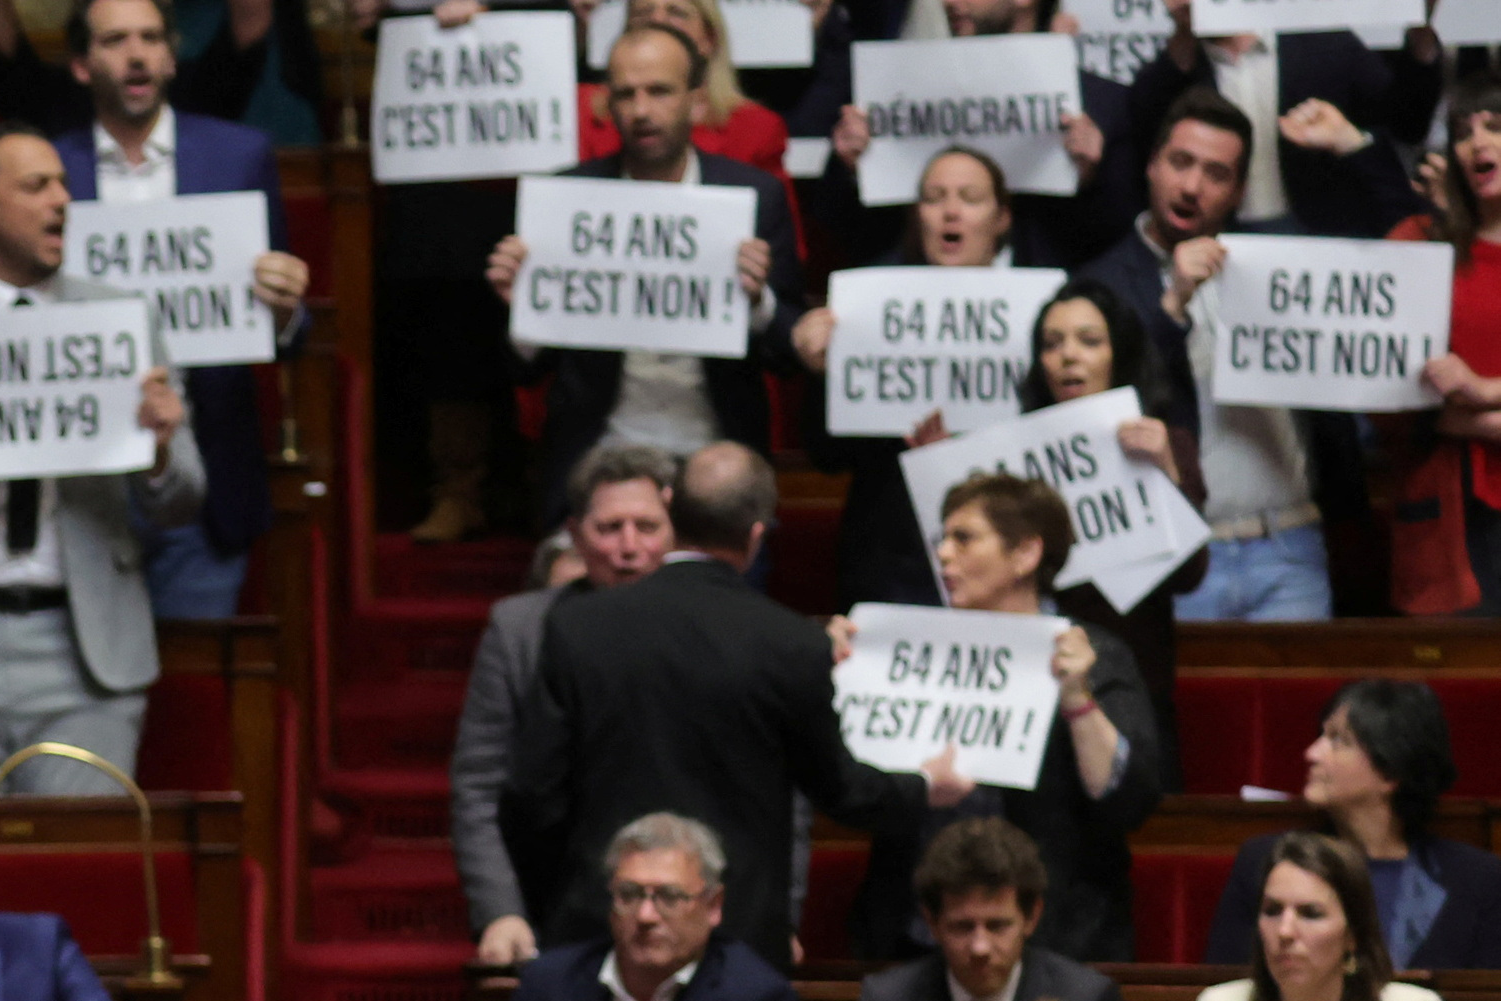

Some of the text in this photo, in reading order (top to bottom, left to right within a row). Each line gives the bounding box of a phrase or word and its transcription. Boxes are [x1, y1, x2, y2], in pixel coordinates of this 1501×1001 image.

[404, 43, 521, 88] 64 ANS
[380, 98, 562, 150] C'EST NON !
[86, 227, 213, 276] 64 ANS
[571, 212, 697, 262] 64 ANS
[156, 287, 231, 331] NON
[530, 267, 734, 323] C'EST NON !
[1268, 269, 1395, 318] 64 ANS
[882, 299, 1009, 344] 64 ANS
[43, 332, 136, 381] C'EST
[1230, 324, 1321, 375] C'EST
[1333, 331, 1407, 378] NON
[844, 357, 1026, 402] C'EST NON
[54, 394, 99, 438] 64
[1076, 480, 1154, 542] ON !
[888, 640, 1013, 692] 64 ANS
[933, 703, 1013, 750] NON
[1018, 708, 1035, 753] !
